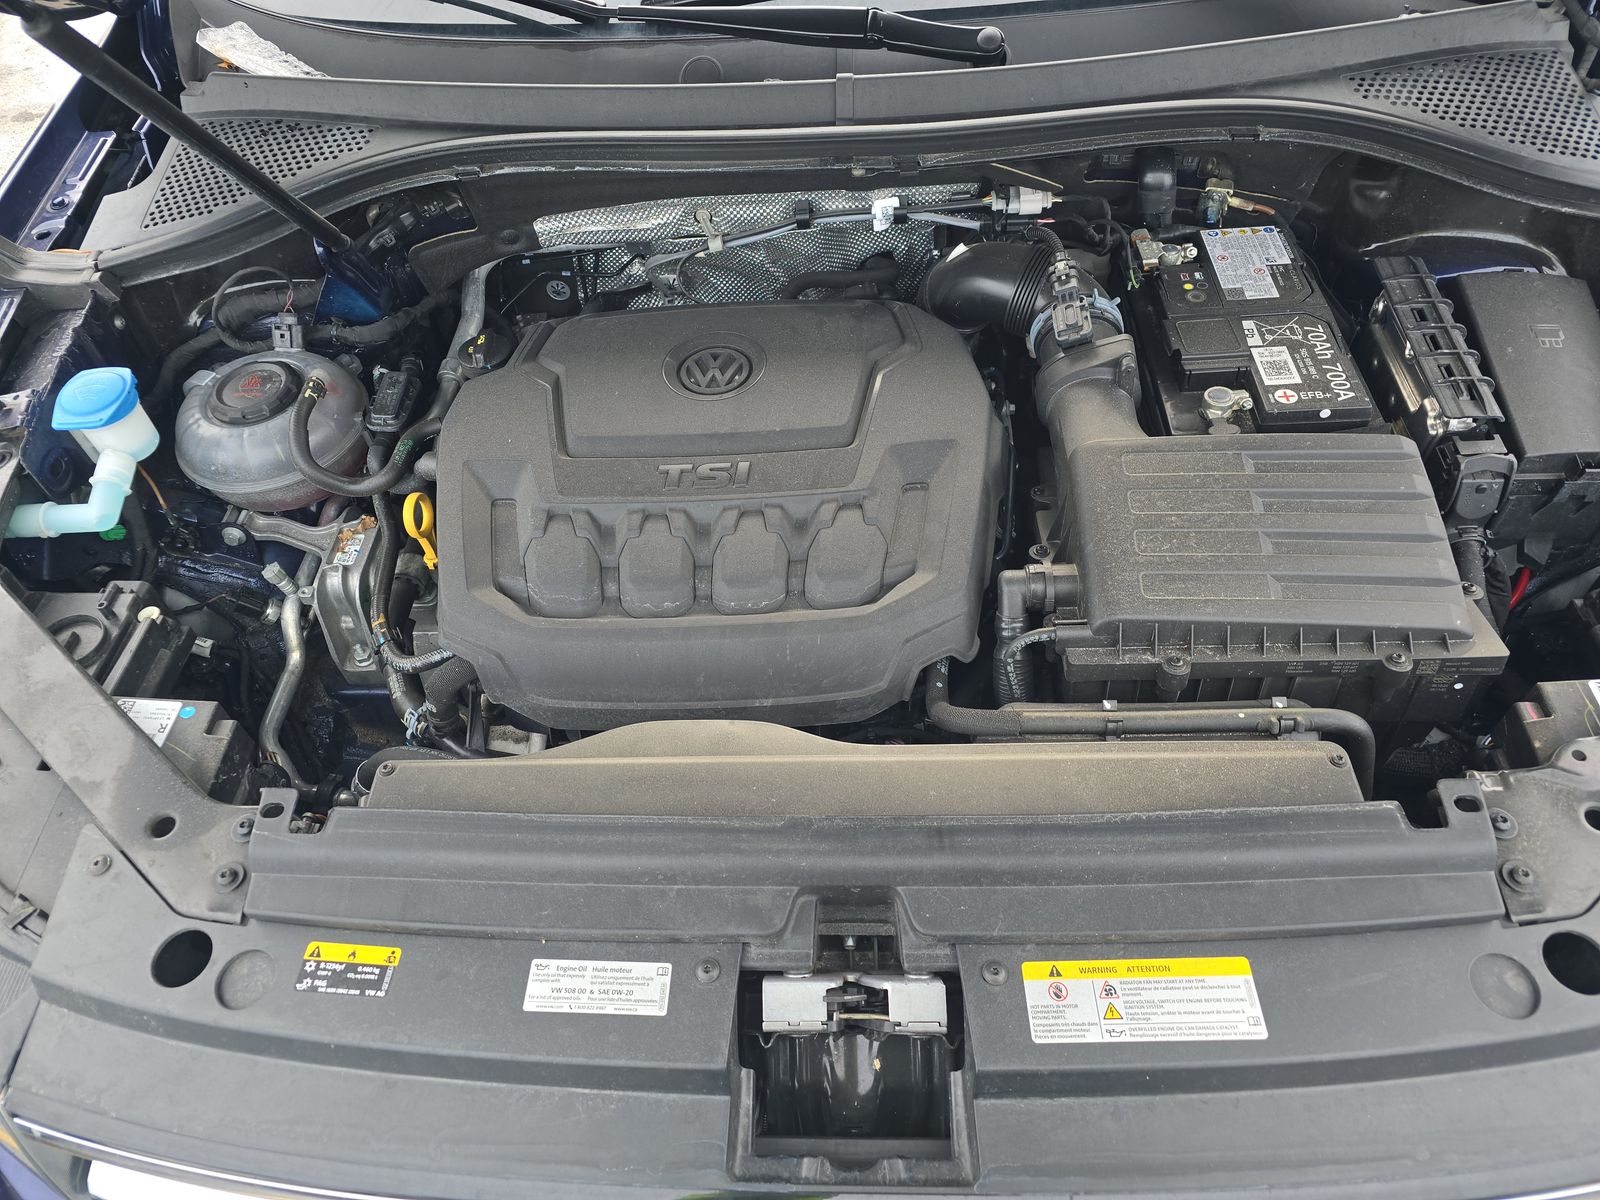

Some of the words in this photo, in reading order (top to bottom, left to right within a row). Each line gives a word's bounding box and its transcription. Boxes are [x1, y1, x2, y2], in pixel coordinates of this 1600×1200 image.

[1304, 324, 1334, 359] 70Ah
[1322, 363, 1356, 401] 700A
[1300, 391, 1332, 400] EFB+
[657, 461, 750, 490] TSI
[556, 965, 577, 973] Engine
[610, 966, 632, 974] moteur
[1078, 966, 1118, 974] WARNING
[1126, 965, 1171, 973] ATTENTION
